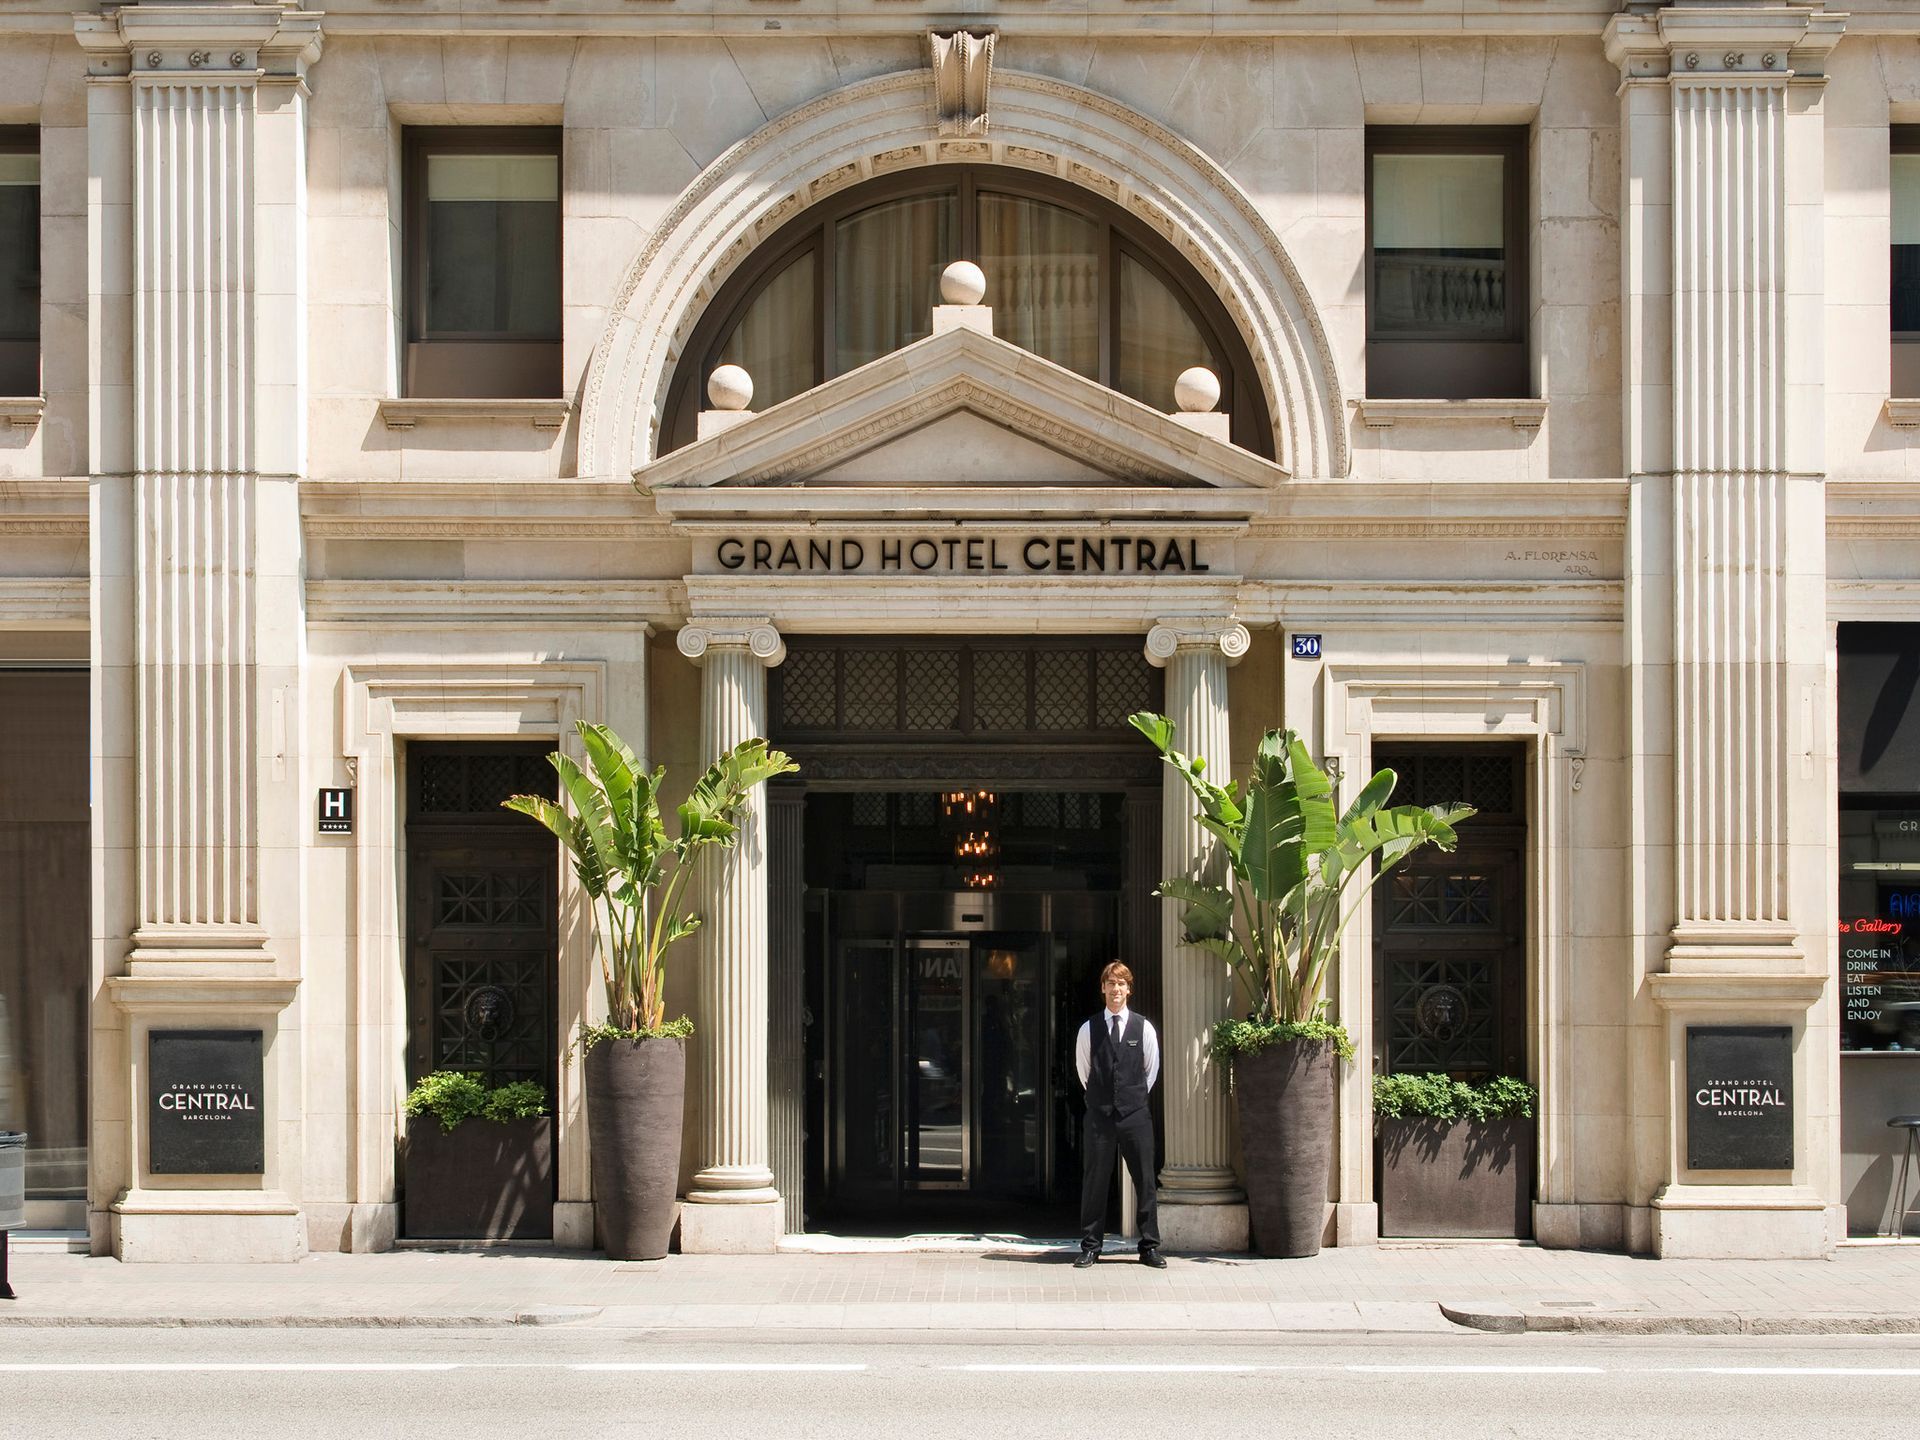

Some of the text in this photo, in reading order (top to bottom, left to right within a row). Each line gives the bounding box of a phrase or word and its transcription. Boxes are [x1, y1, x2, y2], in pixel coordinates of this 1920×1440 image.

[717, 538, 1209, 571] GRAND HOTEL CENTRAL
[1504, 550, 1599, 563] A. FLORENSA
[1296, 637, 1318, 654] 30
[325, 791, 345, 817] H
[1899, 820, 1920, 831] GR
[1837, 918, 1902, 935] he Gallery
[1846, 949, 1891, 959] COME IN
[1846, 961, 1878, 971] DRINK
[1847, 973, 1866, 983] EAT
[1847, 985, 1881, 996] LISTEN
[1847, 998, 1870, 1008] AND
[1847, 1010, 1882, 1020] ENJOY
[159, 1093, 255, 1110] CENTRAL
[1696, 1089, 1786, 1106] CENTRAL
